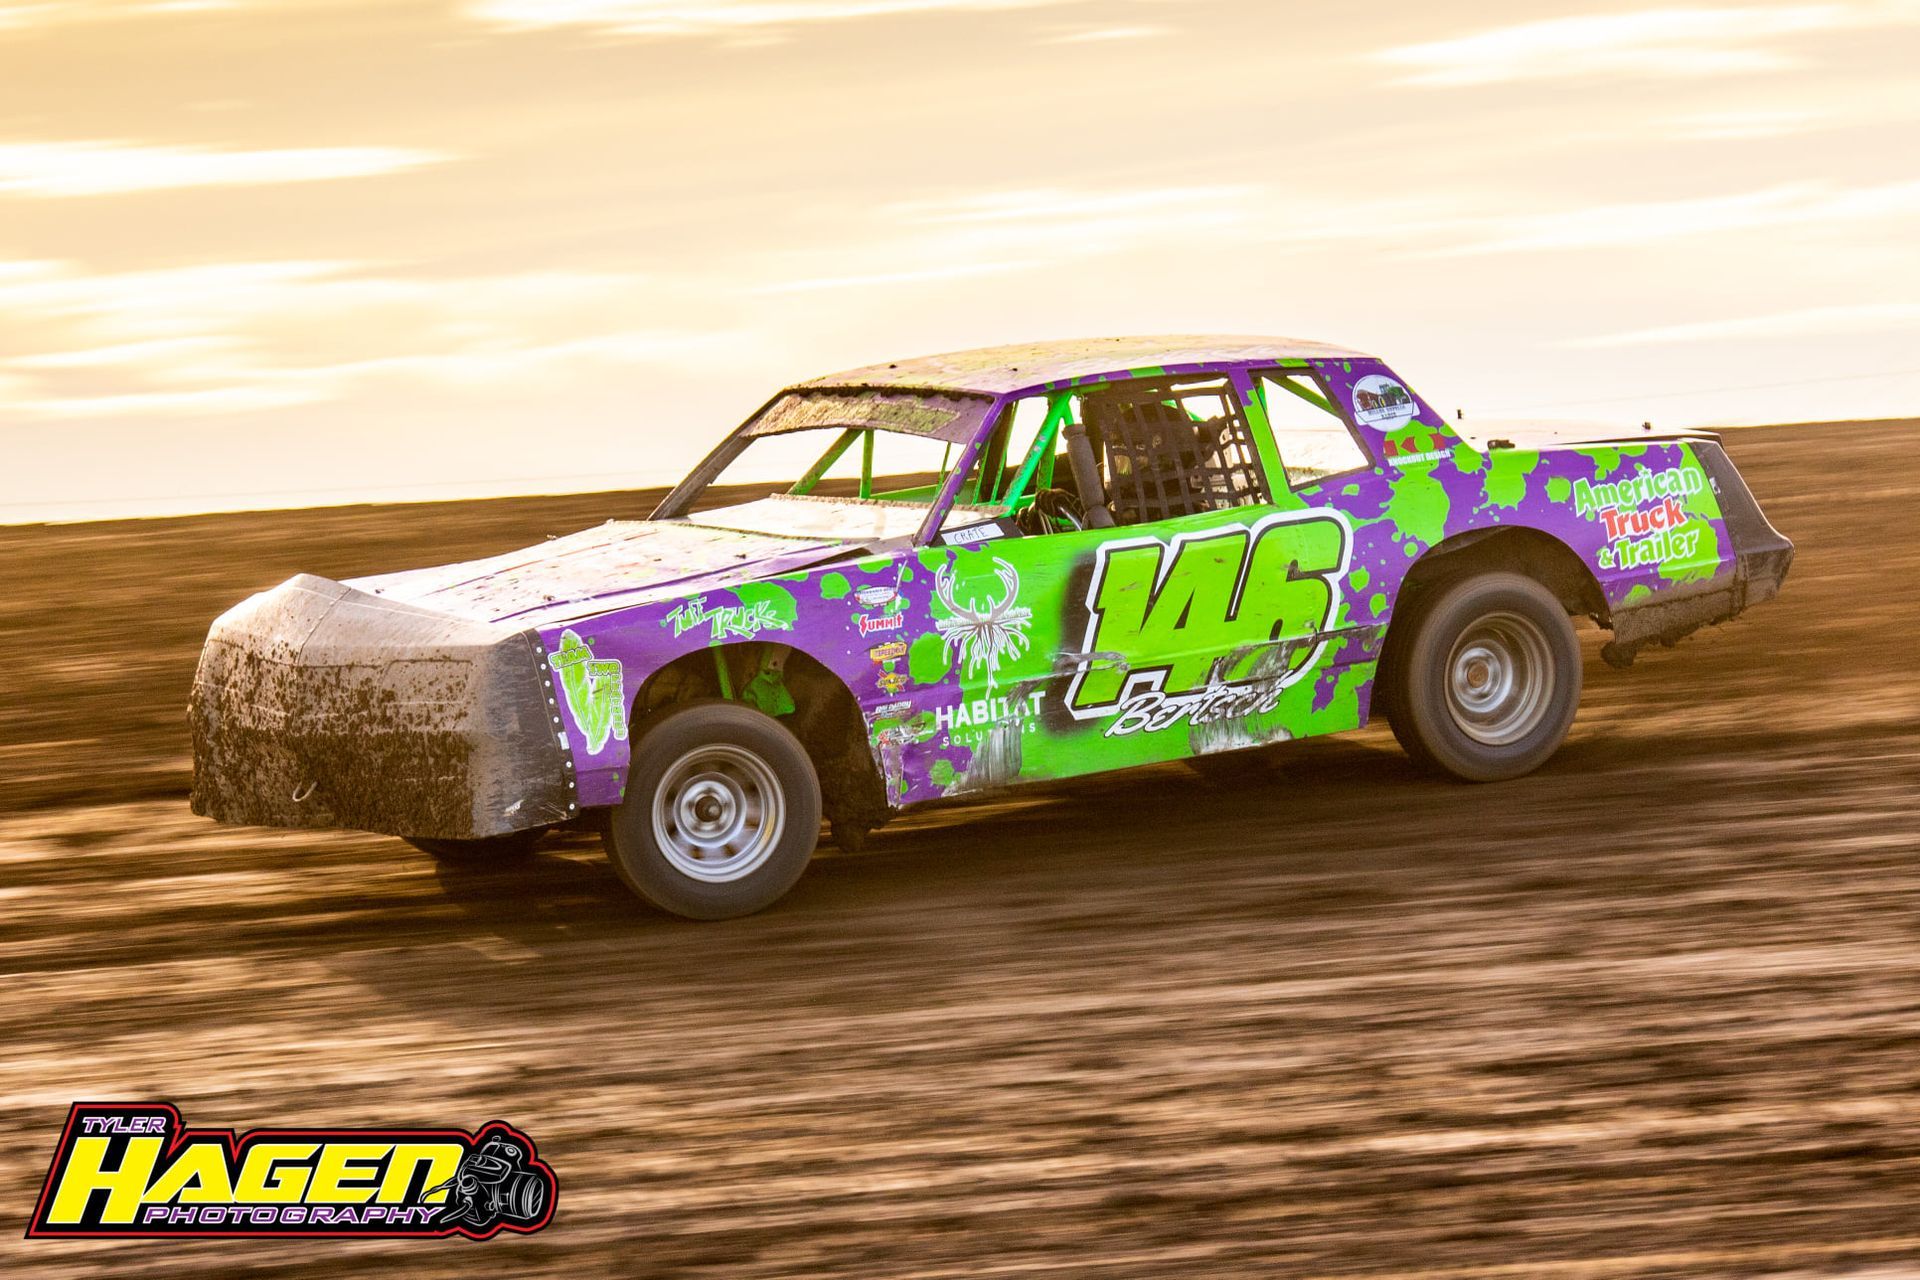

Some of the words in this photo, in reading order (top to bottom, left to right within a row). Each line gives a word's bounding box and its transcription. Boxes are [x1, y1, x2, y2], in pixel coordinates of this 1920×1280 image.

[1573, 467, 1703, 517] American
[954, 526, 988, 544] CRATE
[1600, 497, 1688, 543] Truck
[1598, 547, 1616, 569] &
[1615, 529, 1699, 570] Trailer
[1065, 507, 1354, 720] 146
[549, 646, 592, 669] TEAM
[935, 690, 1046, 731] HABITAT
